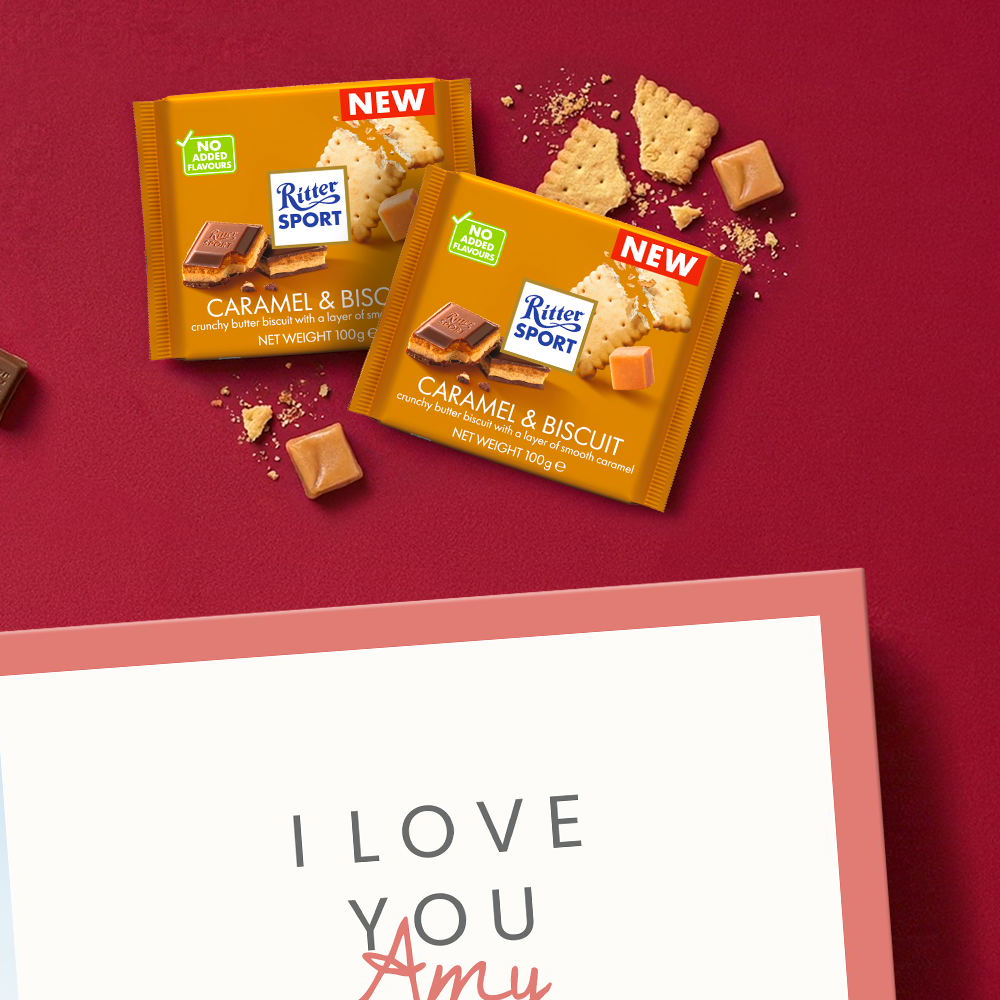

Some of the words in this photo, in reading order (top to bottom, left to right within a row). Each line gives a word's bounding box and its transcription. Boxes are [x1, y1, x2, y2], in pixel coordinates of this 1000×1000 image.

[347, 87, 426, 116] NEW
[192, 151, 228, 162] ADDED
[197, 139, 221, 152] NO
[187, 161, 232, 171] FLAVOURS
[276, 180, 341, 212] Ritter
[278, 210, 342, 230] SPORT
[469, 224, 492, 240] NO
[453, 242, 495, 261] FLAVOURS
[460, 235, 494, 251] ADDED
[620, 234, 699, 277] NEW
[207, 292, 313, 317] CARAMEL
[319, 290, 336, 310] &
[520, 294, 585, 332] Ritter
[191, 319, 229, 332] crunchy
[231, 318, 260, 329] butter
[262, 316, 293, 327] biscuit
[294, 313, 316, 324] with
[317, 315, 325, 323] a
[326, 311, 353, 325] layer
[354, 309, 365, 320] of
[258, 333, 280, 346] NET
[282, 330, 332, 344] WEIGHT
[513, 322, 578, 354] SPORT
[418, 376, 515, 423] CARAMEL
[521, 409, 536, 430] &
[541, 415, 625, 456] BISCUIT
[396, 392, 433, 412] crunchy
[434, 401, 462, 418] butter
[463, 410, 493, 429] biscuit
[494, 424, 513, 436] with
[523, 430, 549, 446] layer
[549, 440, 562, 450] of
[560, 445, 595, 461] smooth
[596, 457, 635, 475] caramel
[451, 426, 475, 443] NET
[477, 434, 524, 458] WEIGHT
[292, 814, 304, 868] I
[350, 793, 583, 864] LOVE
[347, 886, 535, 951] YOU
